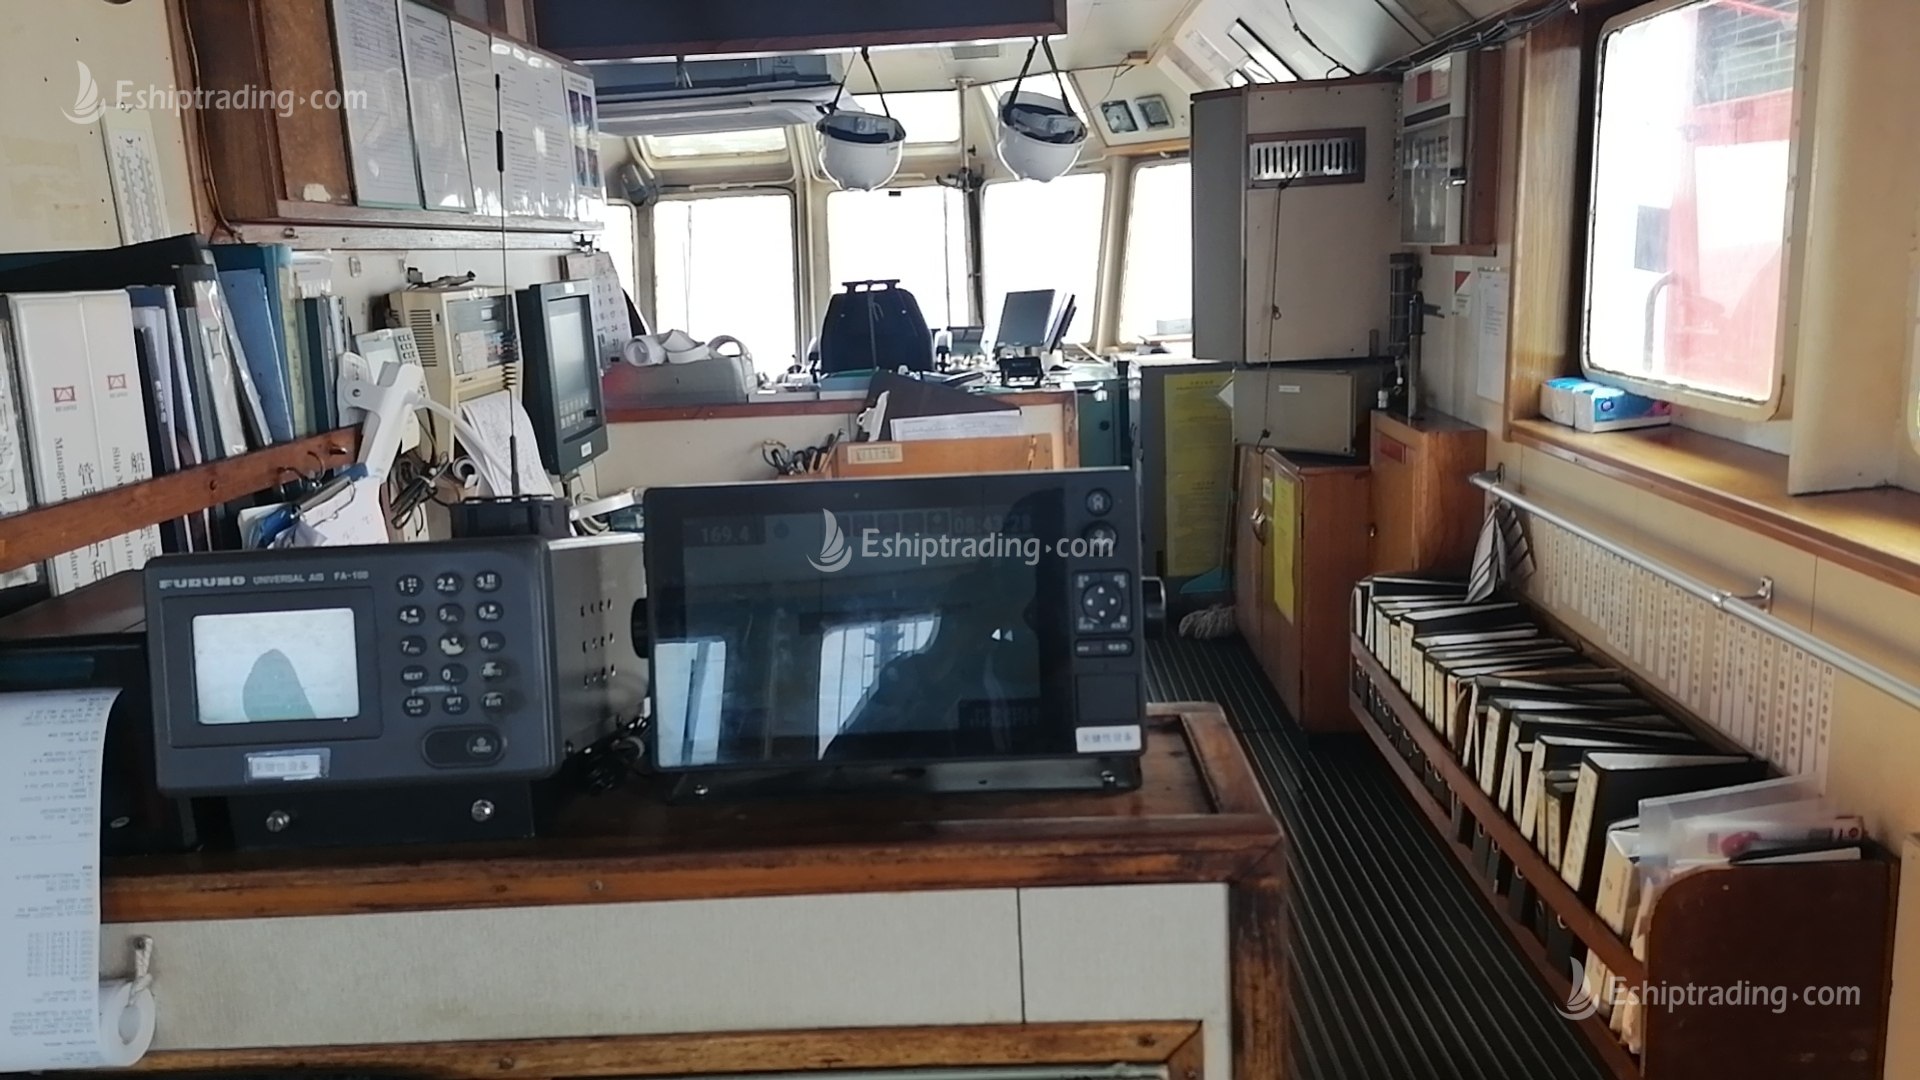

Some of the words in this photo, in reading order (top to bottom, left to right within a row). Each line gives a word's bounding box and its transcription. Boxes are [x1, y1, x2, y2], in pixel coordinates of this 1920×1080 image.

[159, 576, 246, 590] FURUNO
[252, 574, 305, 586] UNIVERSAL
[442, 669, 451, 681] 0
